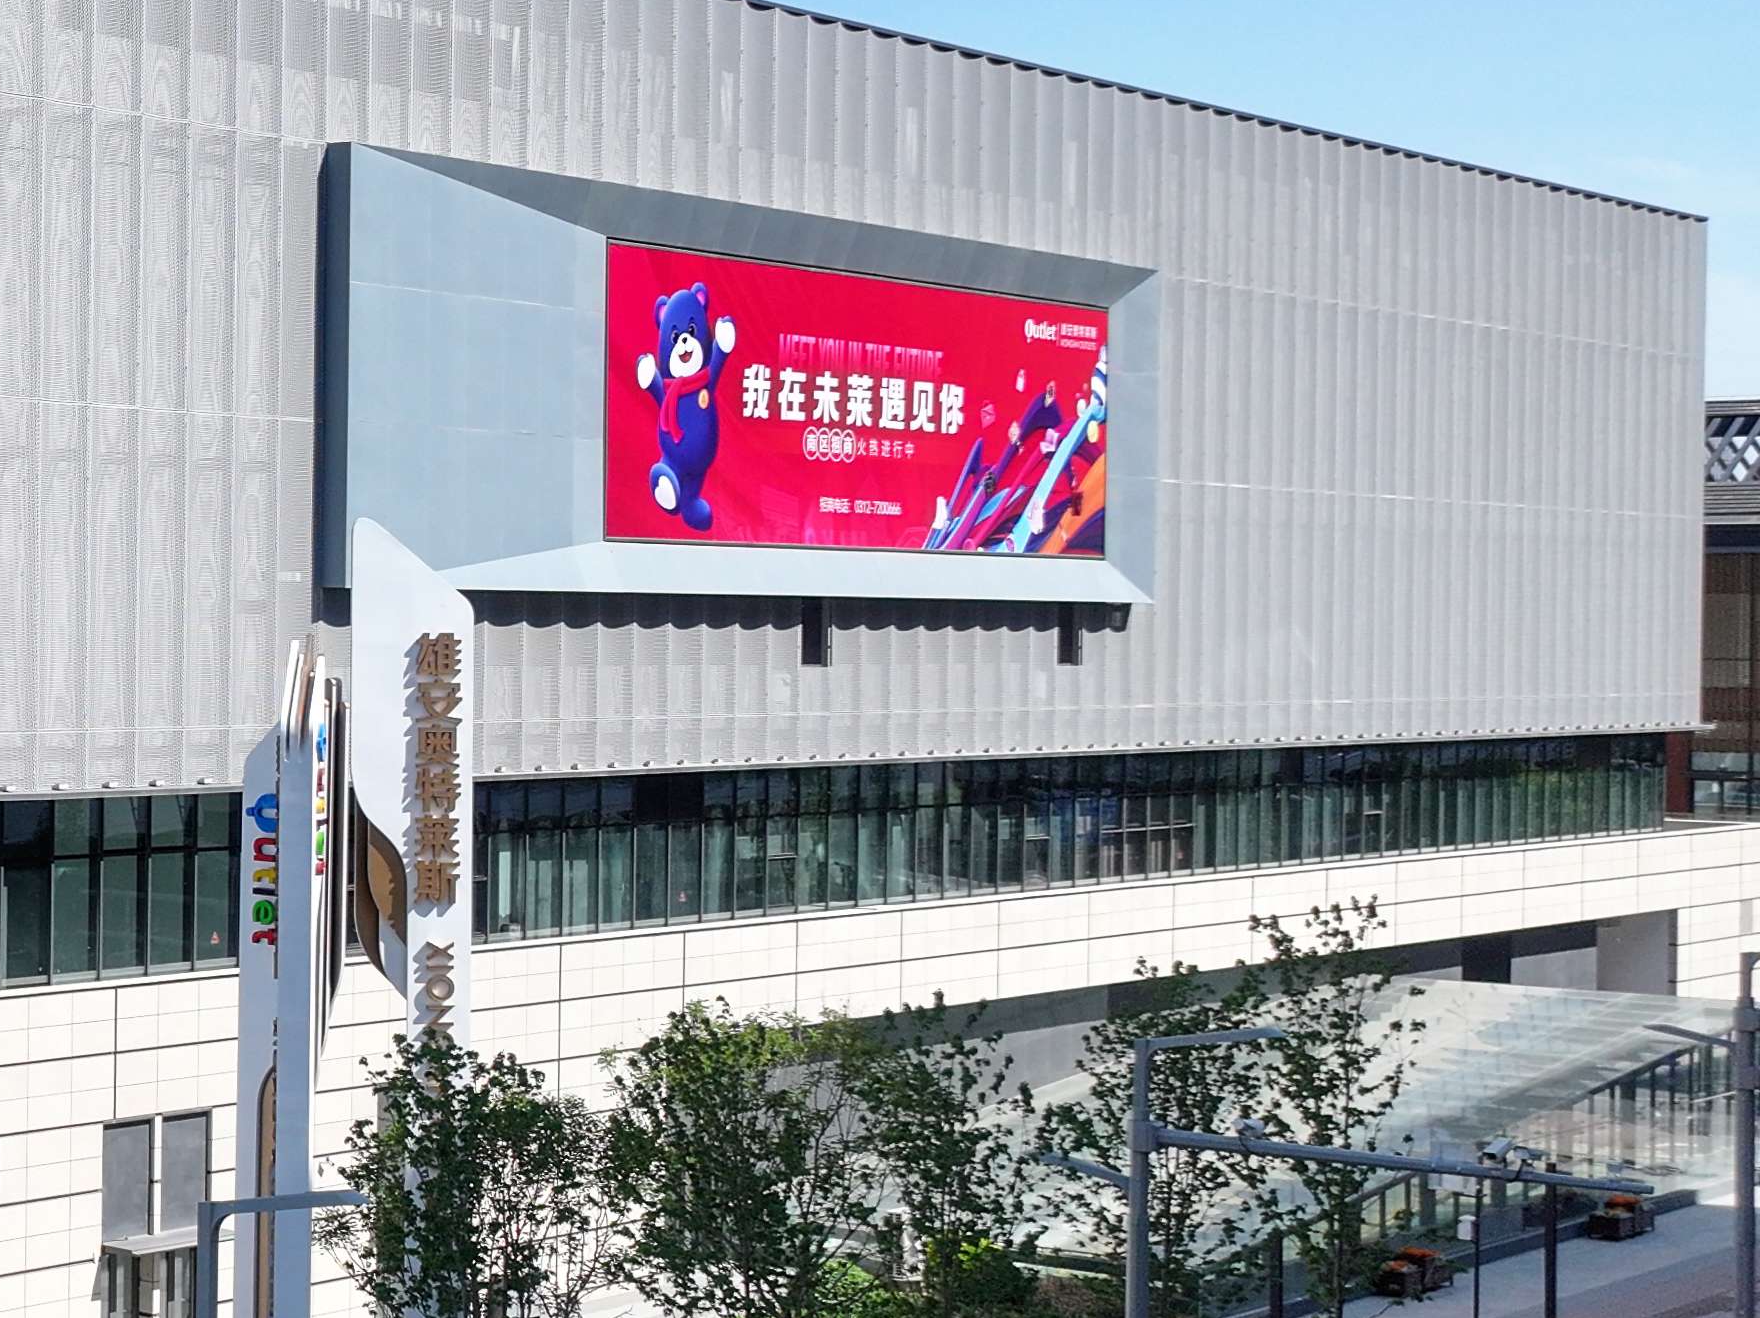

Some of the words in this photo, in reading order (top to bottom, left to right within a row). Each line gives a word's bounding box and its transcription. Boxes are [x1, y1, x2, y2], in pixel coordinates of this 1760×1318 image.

[742, 363, 966, 435] 我在未莱遇见你
[415, 632, 462, 905] 雄安奥特莱斯
[245, 792, 278, 946] Outlet
